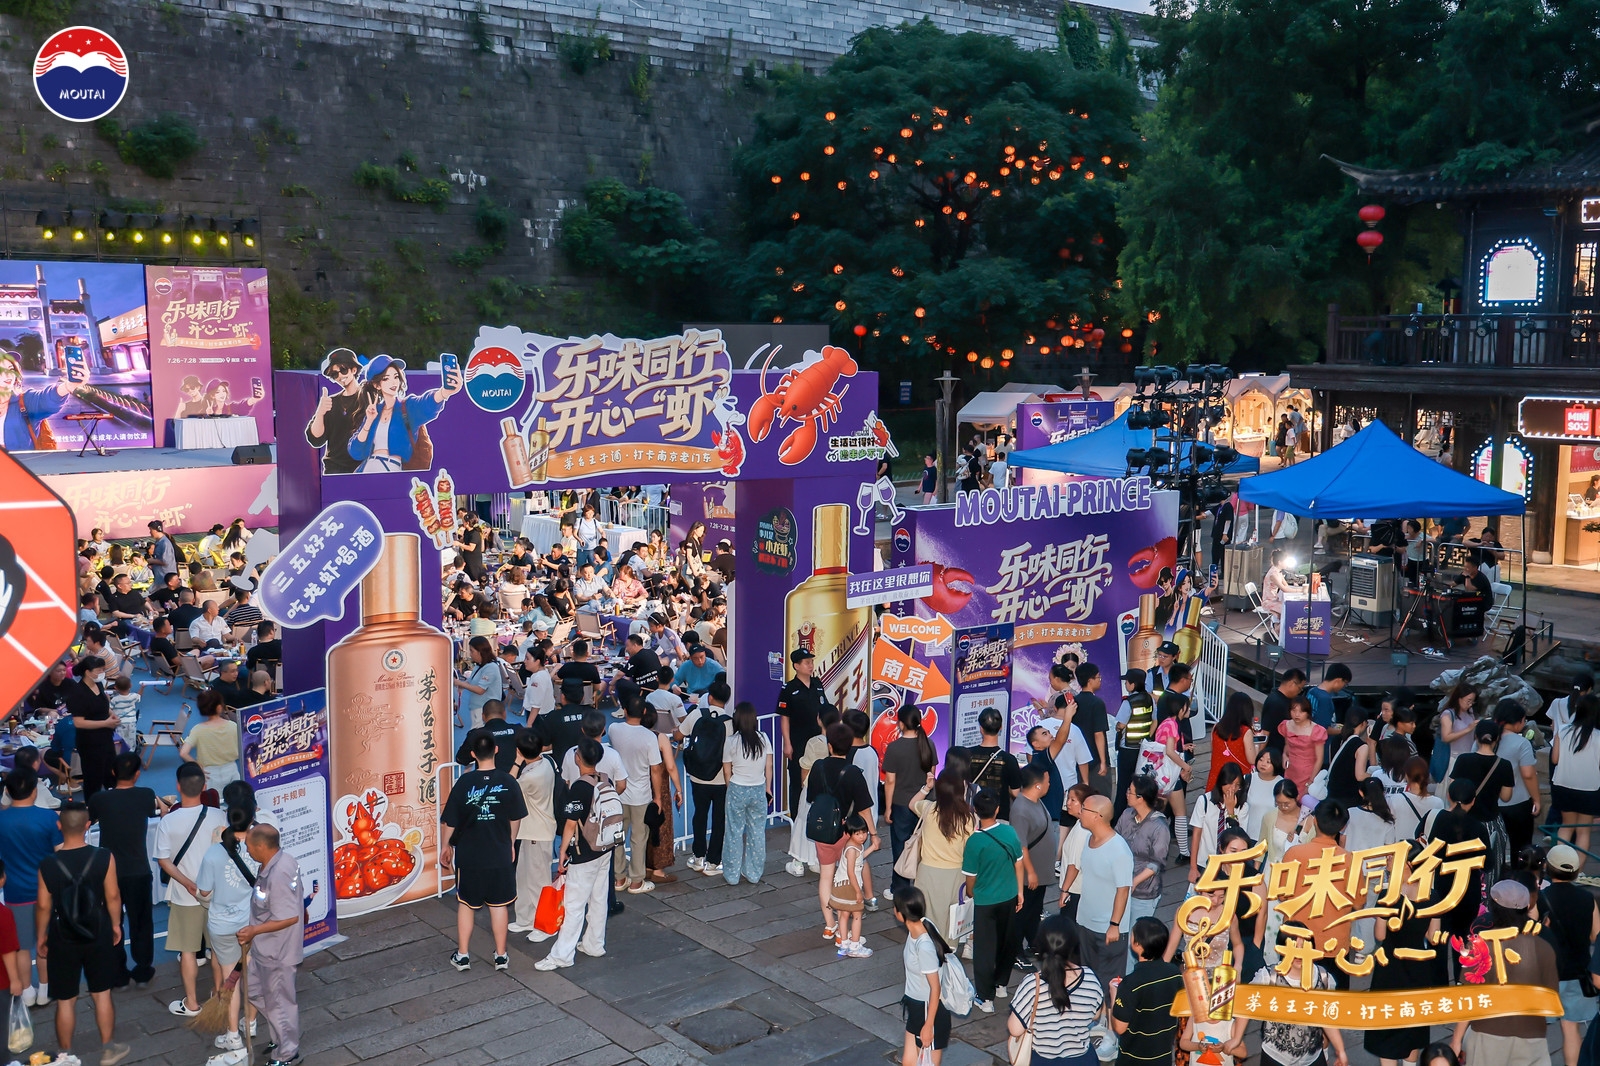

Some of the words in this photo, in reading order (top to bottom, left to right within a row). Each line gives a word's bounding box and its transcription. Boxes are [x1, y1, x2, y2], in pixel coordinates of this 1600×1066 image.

[161, 298, 240, 324] 乐味同行
[536, 329, 728, 402] 乐味同行
[481, 388, 512, 398] MOUTAI
[1568, 412, 1589, 421] MINI
[831, 438, 875, 448] 生活过得好
[63, 475, 171, 513] 乐味同行
[957, 484, 1060, 525] MOUTAI
[1066, 478, 1151, 515] PRINCE
[271, 515, 344, 593] 三五好友
[986, 534, 1112, 594] 乐味同行
[286, 525, 375, 619] 吃龙虾喝酒
[849, 571, 931, 594] 我在这里很想你
[831, 621, 861, 664] PRINCE
[889, 622, 942, 636] WELCOME
[965, 639, 1008, 662] 乐味同行
[880, 657, 928, 689] 南京
[258, 711, 319, 748] 乐味同行
[418, 669, 438, 804] 茅台王子酒
[272, 787, 307, 806] 打卡规则
